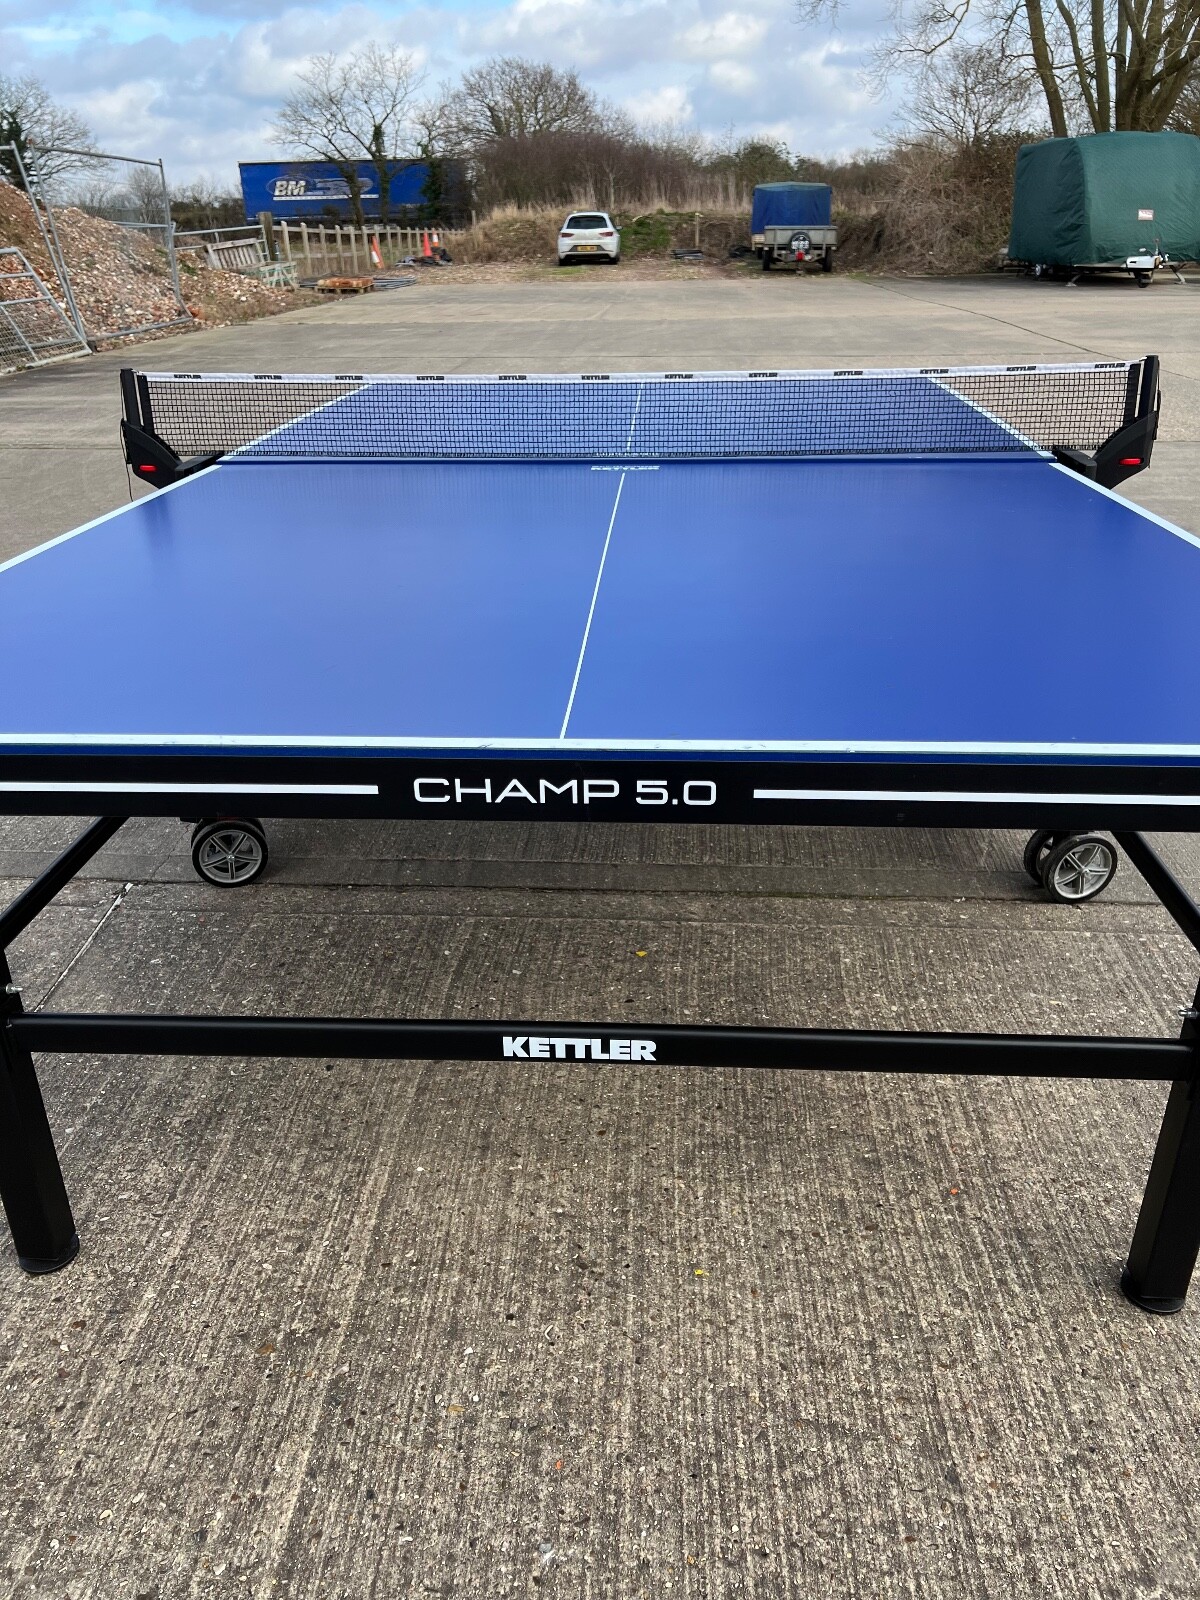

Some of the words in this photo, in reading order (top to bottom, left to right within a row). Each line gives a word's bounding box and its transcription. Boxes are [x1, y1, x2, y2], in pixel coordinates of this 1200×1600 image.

[274, 180, 306, 196] BM
[413, 777, 620, 804] CHAMP
[635, 780, 717, 806] 5.0
[502, 1036, 657, 1061] KETTLER
